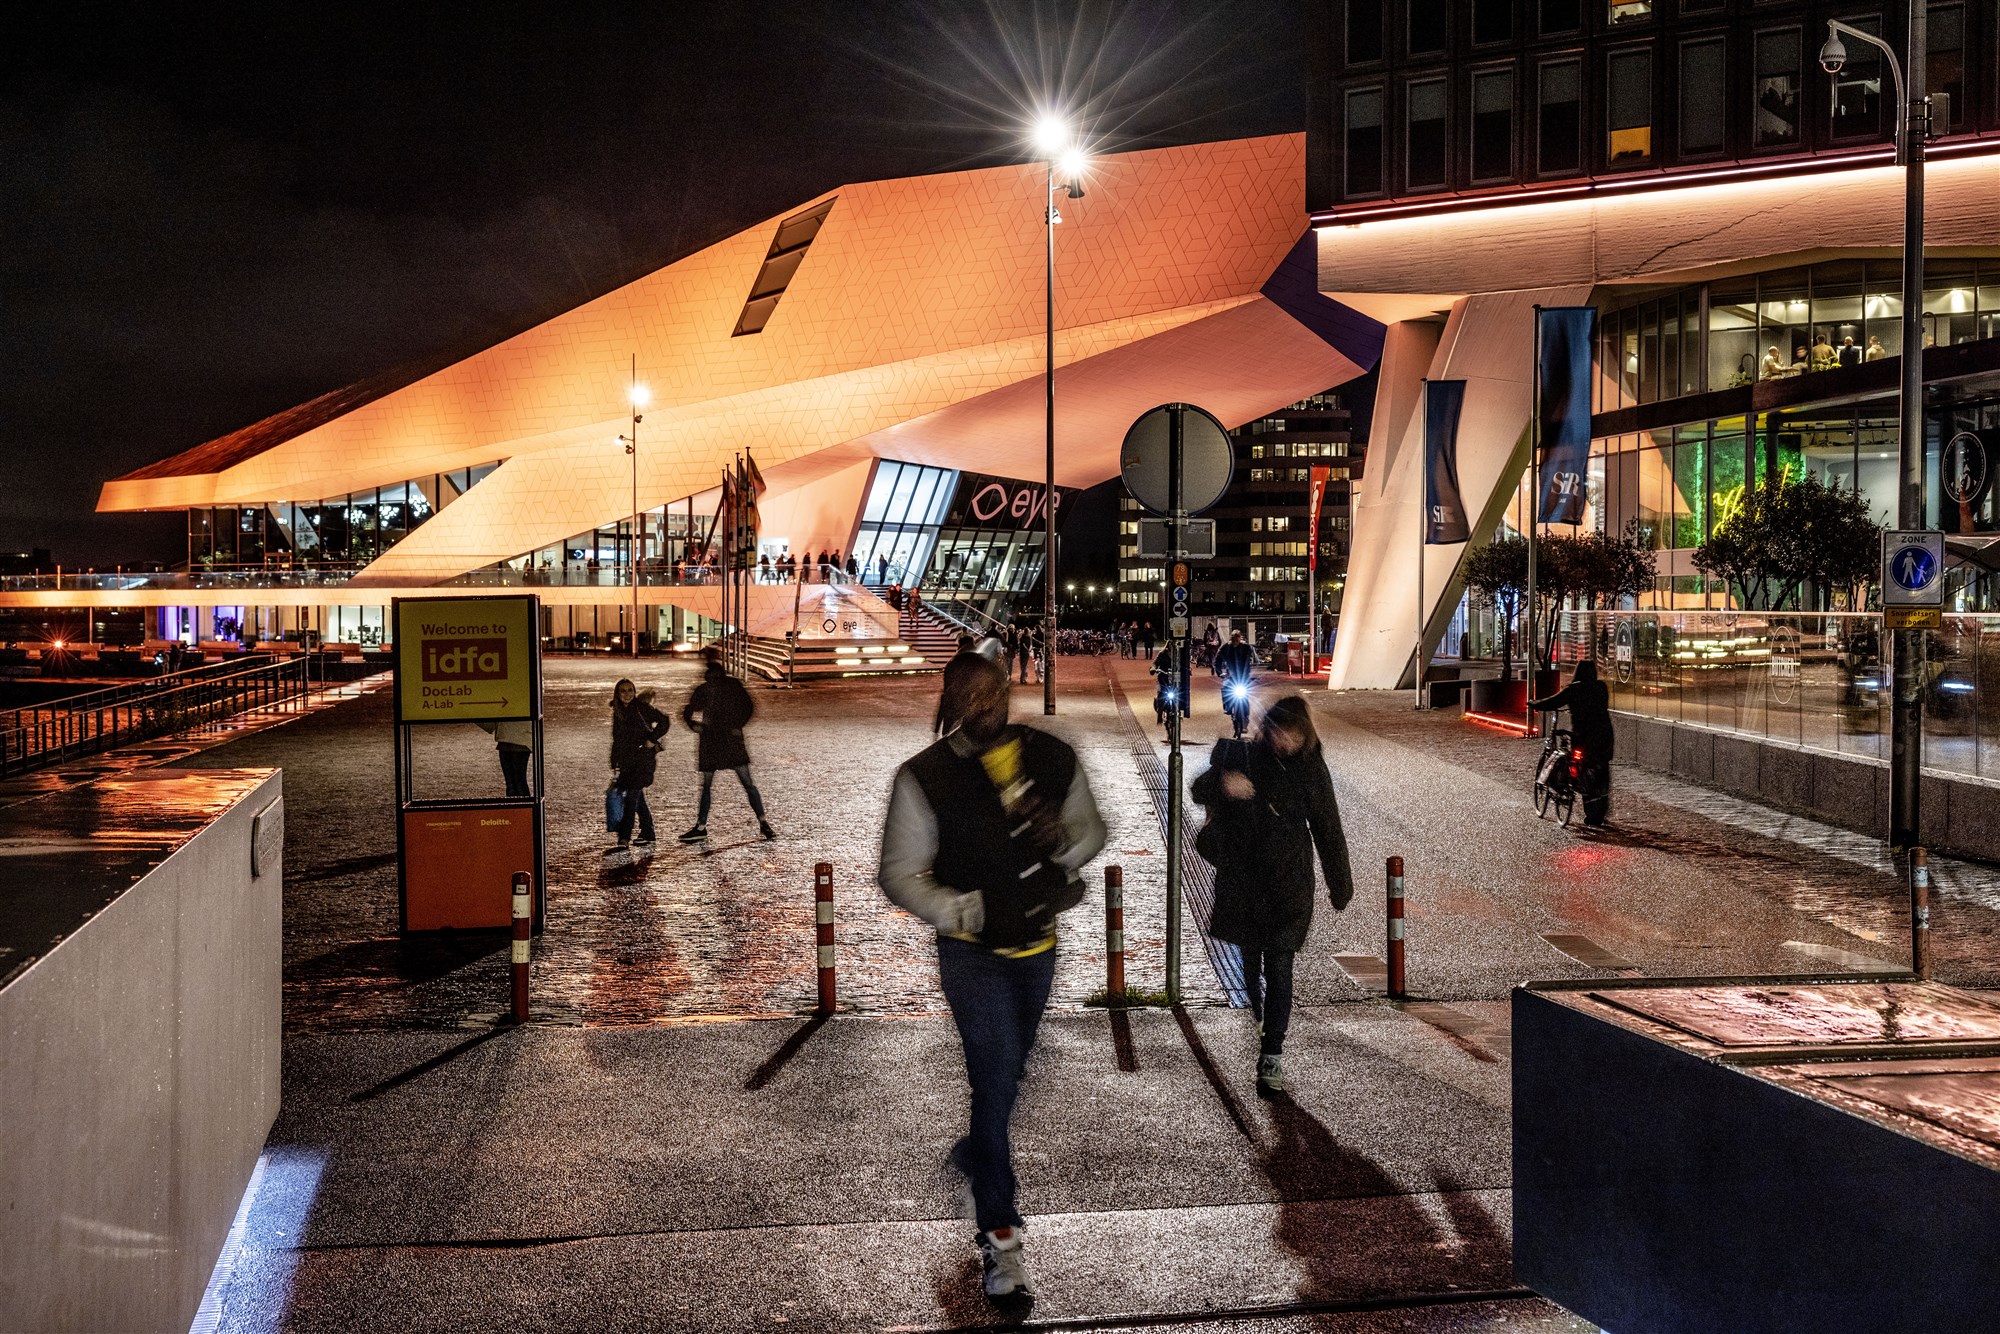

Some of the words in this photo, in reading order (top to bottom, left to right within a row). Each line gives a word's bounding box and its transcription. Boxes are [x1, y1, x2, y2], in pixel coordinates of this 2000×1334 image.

[1012, 489, 1060, 528] eye
[1309, 481, 1321, 559] LOOKOUT
[421, 623, 489, 635] Welcome
[493, 623, 507, 634] to
[843, 621, 857, 632] eye
[429, 646, 500, 674] idfa
[422, 685, 472, 697] DocLab
[422, 700, 454, 709] A-Lab
